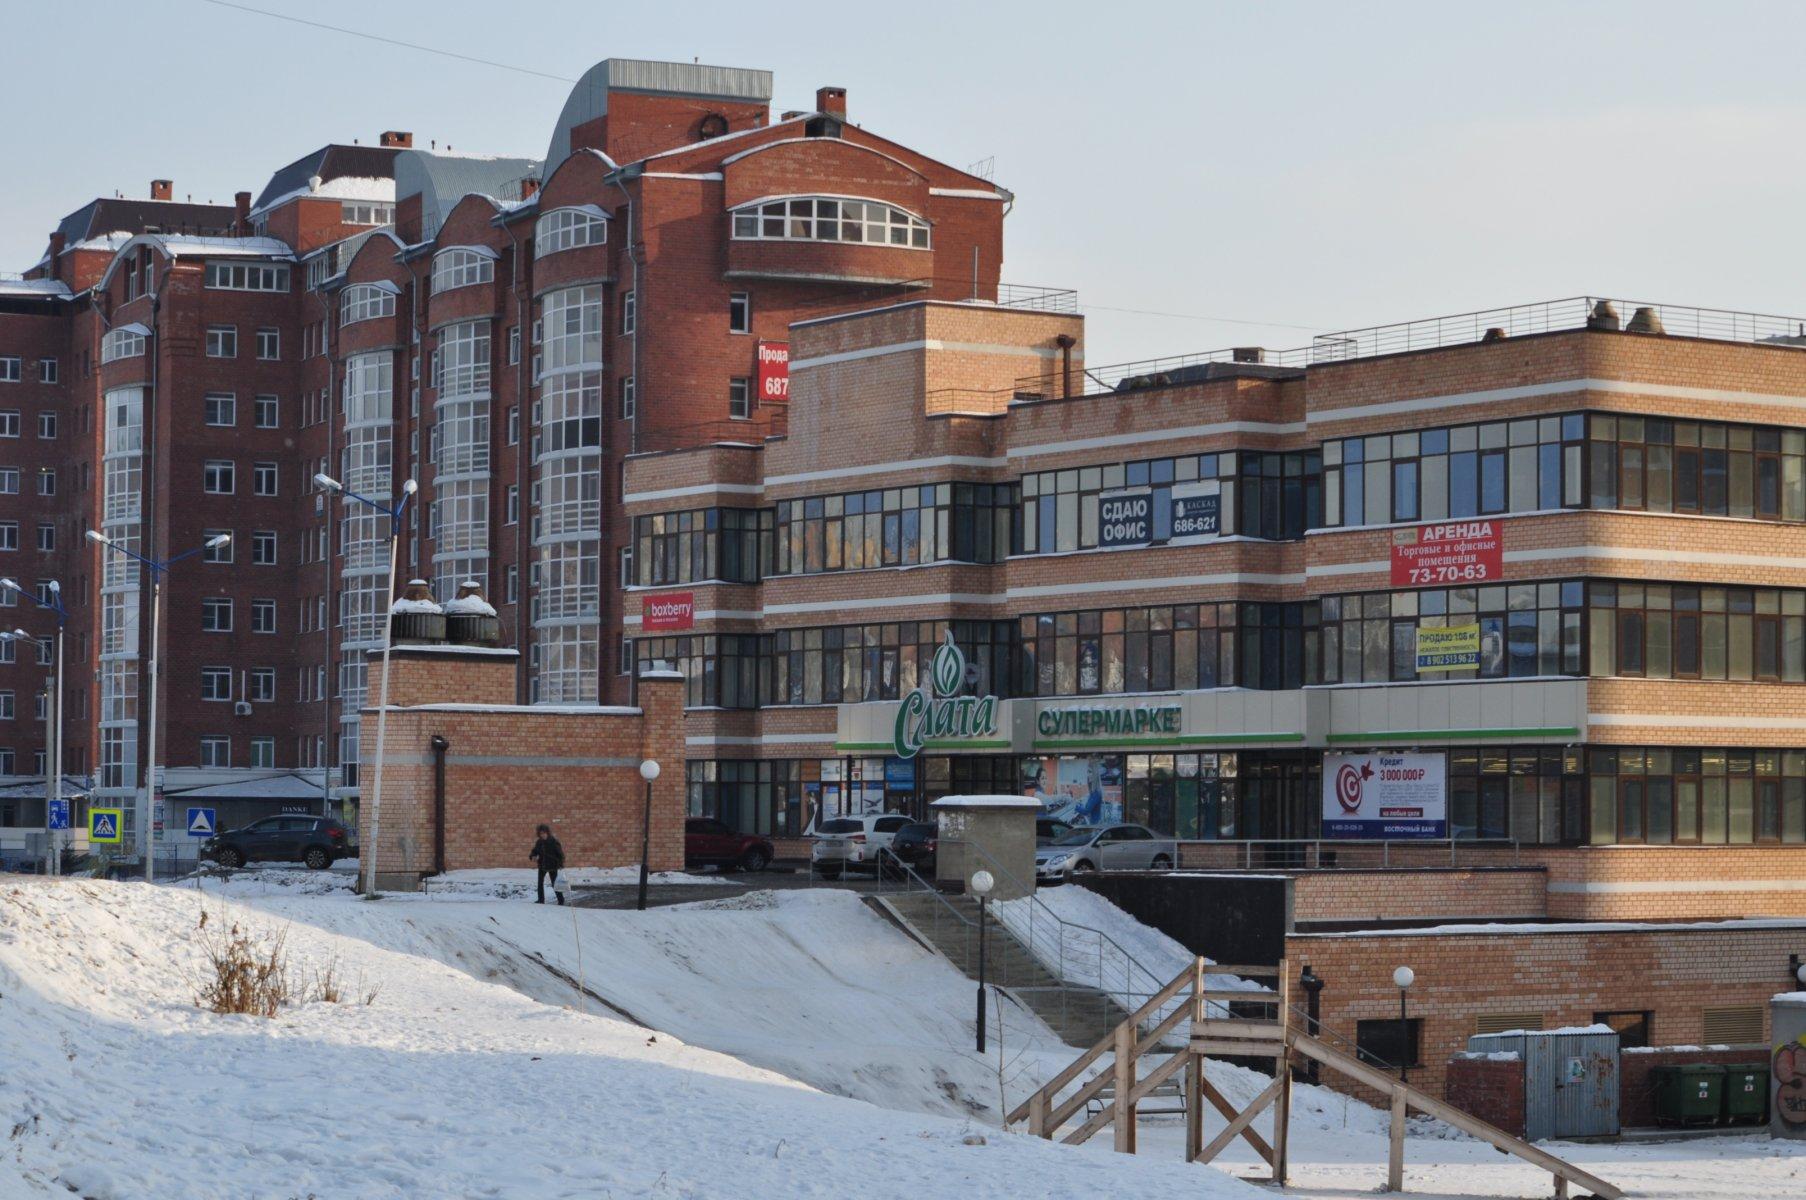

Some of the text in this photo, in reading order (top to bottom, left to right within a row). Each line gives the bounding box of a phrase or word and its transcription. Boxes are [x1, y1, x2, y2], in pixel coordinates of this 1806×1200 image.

[759, 345, 788, 363] Прода
[765, 377, 788, 395] 687
[1102, 499, 1147, 521] СДАЮ
[1103, 521, 1146, 541] ОФИС
[1174, 516, 1216, 533] 686-621
[1423, 522, 1492, 540] АРЕНДА
[1397, 545, 1441, 558] Торговые
[1453, 540, 1496, 555] офисные
[1418, 554, 1477, 567] помещения
[1409, 564, 1487, 583] 73-70-63
[651, 602, 691, 617] boxberry
[1419, 632, 1453, 644] ПРОДАЮ
[893, 687, 998, 759] Слата
[1380, 758, 1403, 767] Кредит
